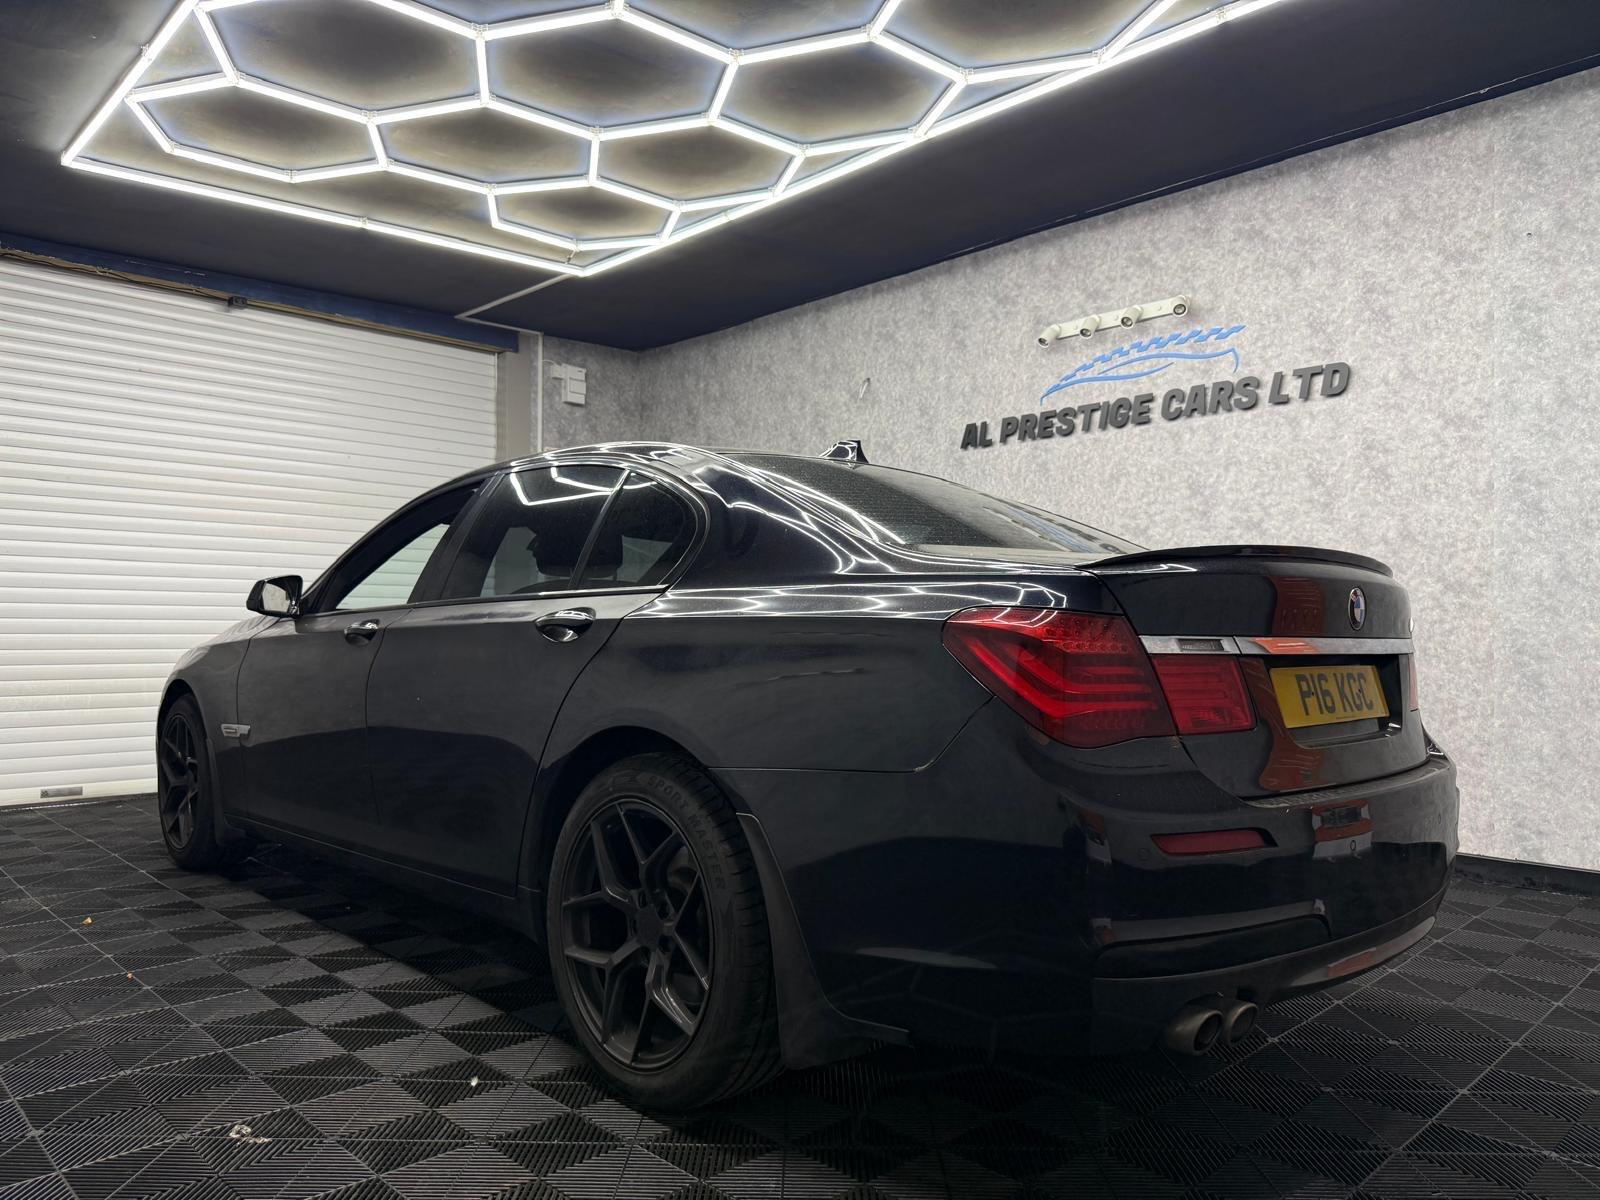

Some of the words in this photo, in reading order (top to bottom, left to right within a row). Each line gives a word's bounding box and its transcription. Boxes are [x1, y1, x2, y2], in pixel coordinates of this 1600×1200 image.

[961, 421, 993, 450] AL
[1000, 393, 1154, 443] PRESTIGE
[1160, 376, 1260, 422] CARS
[1268, 361, 1351, 405] LTD
[1295, 673, 1336, 716] P16
[1333, 672, 1374, 712] KGC
